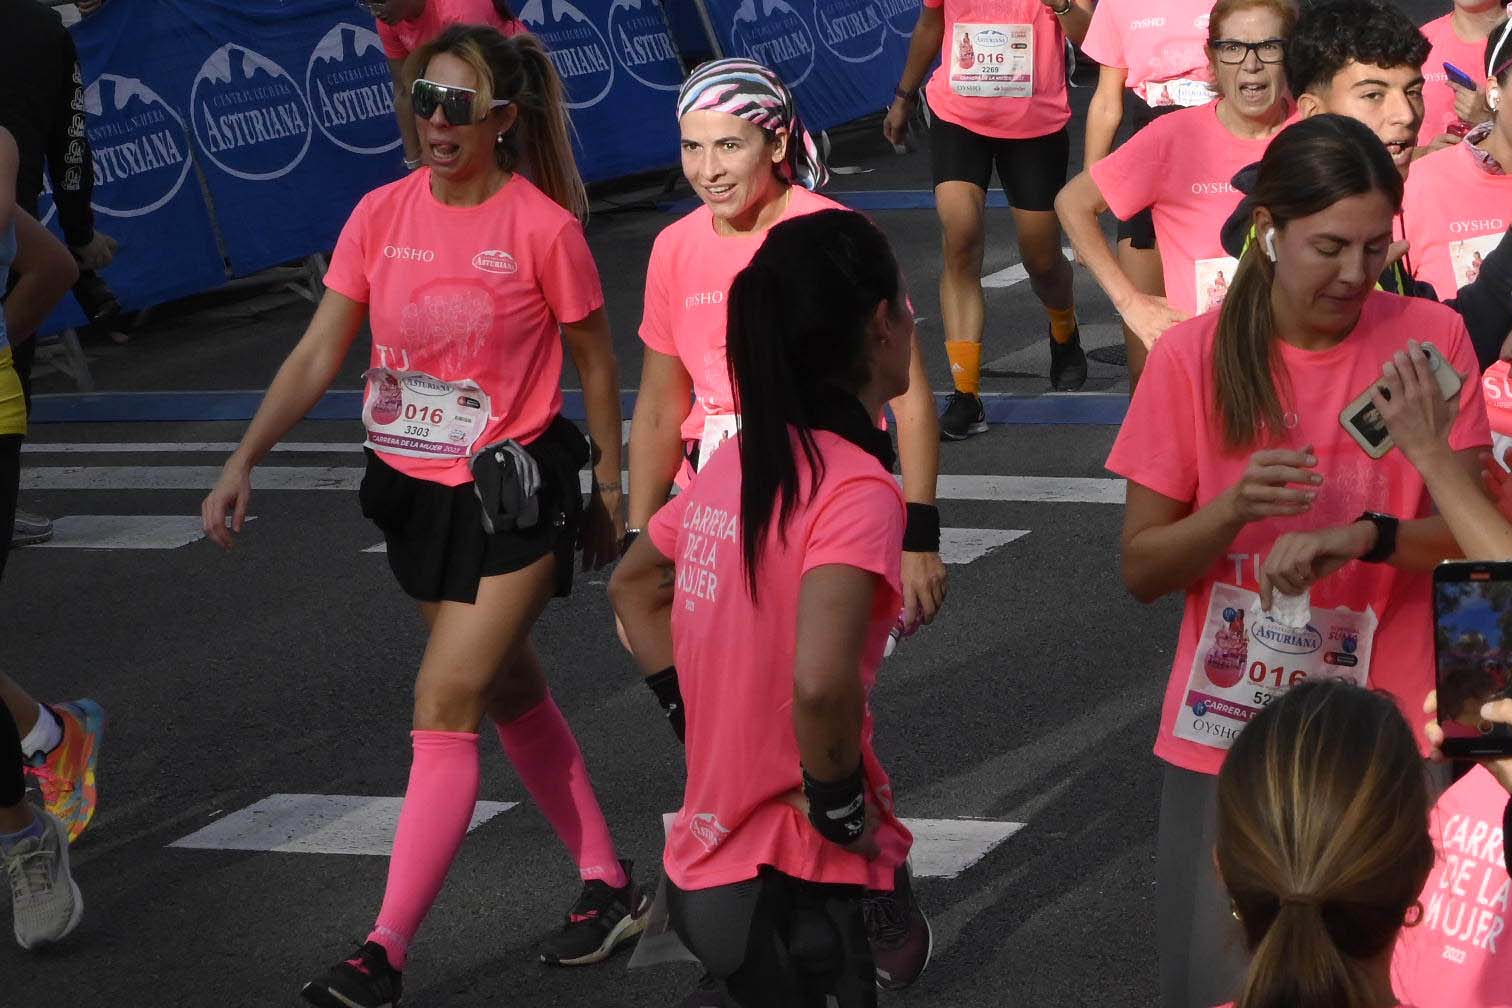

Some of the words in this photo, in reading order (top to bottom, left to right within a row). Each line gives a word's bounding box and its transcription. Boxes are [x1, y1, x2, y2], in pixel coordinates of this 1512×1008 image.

[977, 53, 1004, 63] 016
[203, 100, 307, 153] ASTURIANA
[1450, 218, 1503, 233] OYSHO
[384, 245, 434, 263] OYSHO
[404, 403, 444, 424] 016
[404, 425, 430, 438] 3303
[683, 501, 737, 544] CARRERA
[684, 533, 702, 563] DE
[700, 537, 717, 570] LA
[678, 565, 717, 603] MUJER
[1255, 625, 1318, 649] ASTURIANA
[1203, 698, 1247, 720] CARRERA
[1439, 857, 1473, 897] DE
[1476, 867, 1511, 914] LA
[1423, 896, 1504, 955] MUJER
[1442, 943, 1466, 965] 2023
